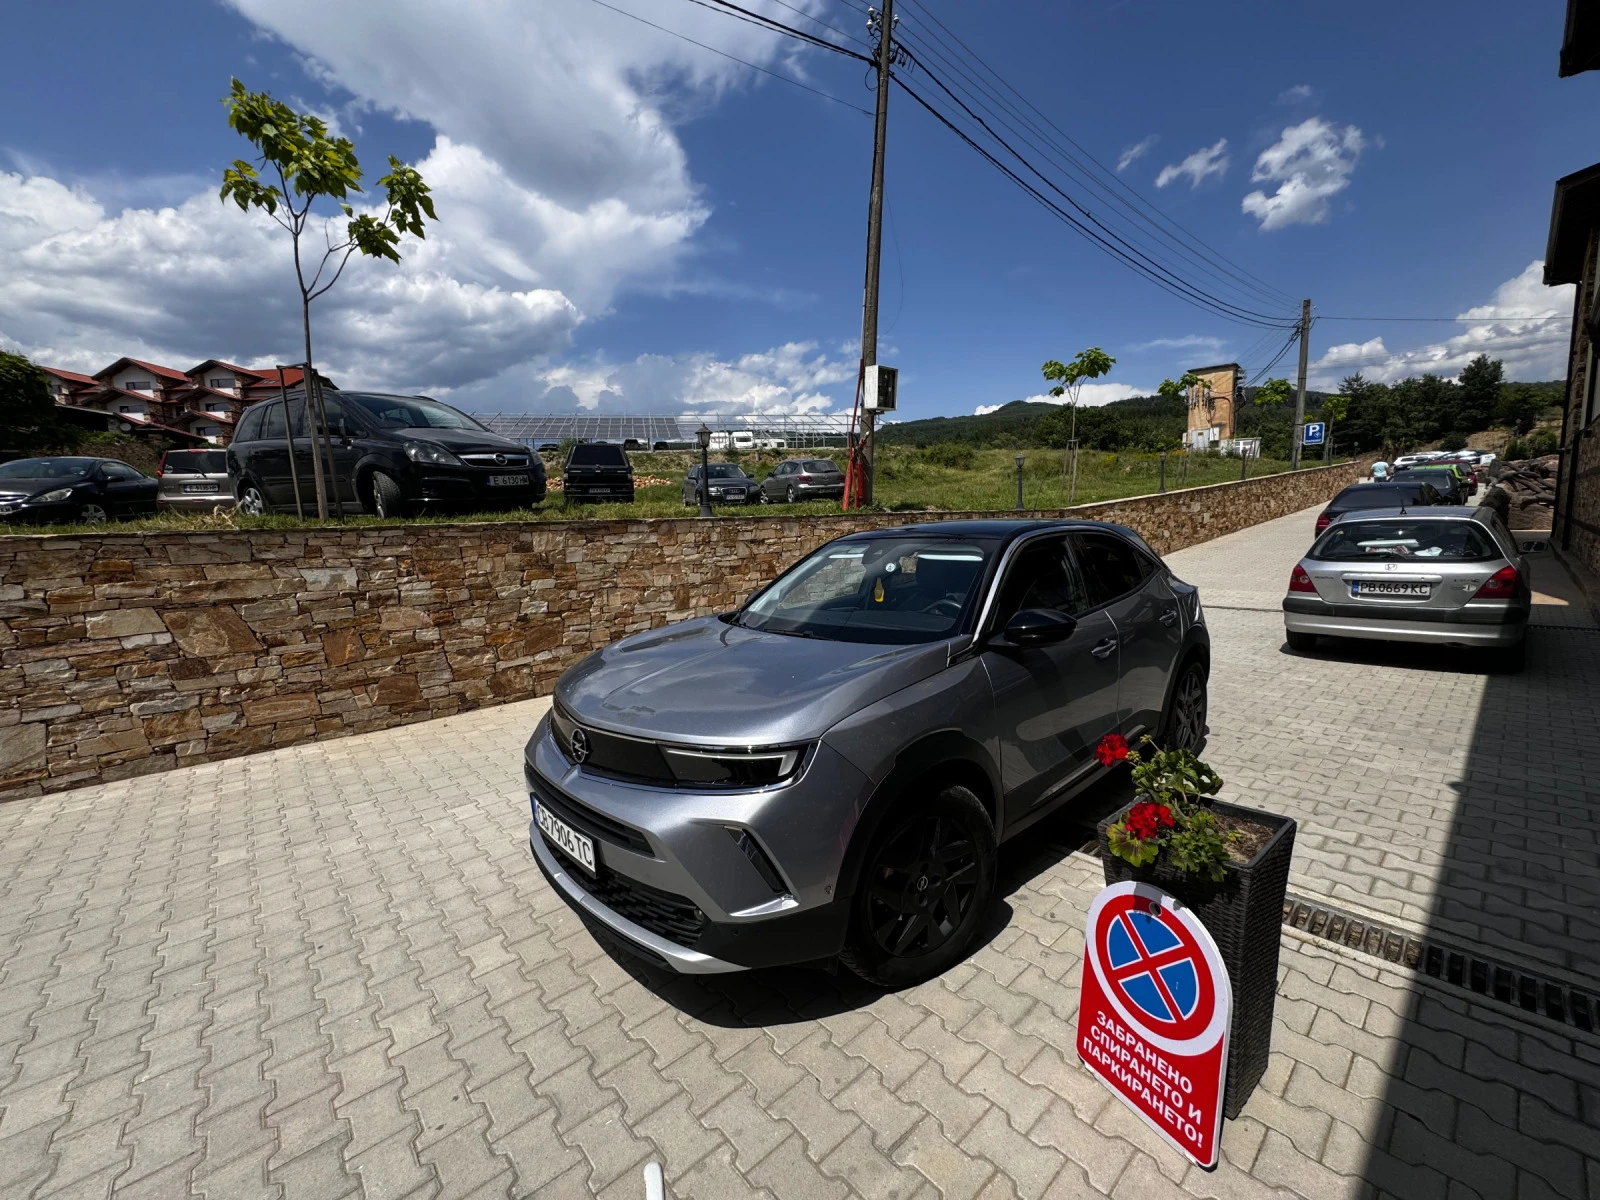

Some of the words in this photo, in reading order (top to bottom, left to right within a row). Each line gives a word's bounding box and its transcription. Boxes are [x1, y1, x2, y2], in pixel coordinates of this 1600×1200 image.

[1309, 425, 1320, 436] P
[1378, 583, 1408, 593] 0669
[548, 814, 575, 853] 7906
[574, 834, 593, 867] TC
[1090, 1025, 1183, 1109] СПИРАНЕТО
[1188, 1102, 1202, 1126] И
[1096, 1010, 1193, 1094] ЗАБРАНЕНО
[1083, 1035, 1203, 1149] ПАРКИРАНЕТО!
